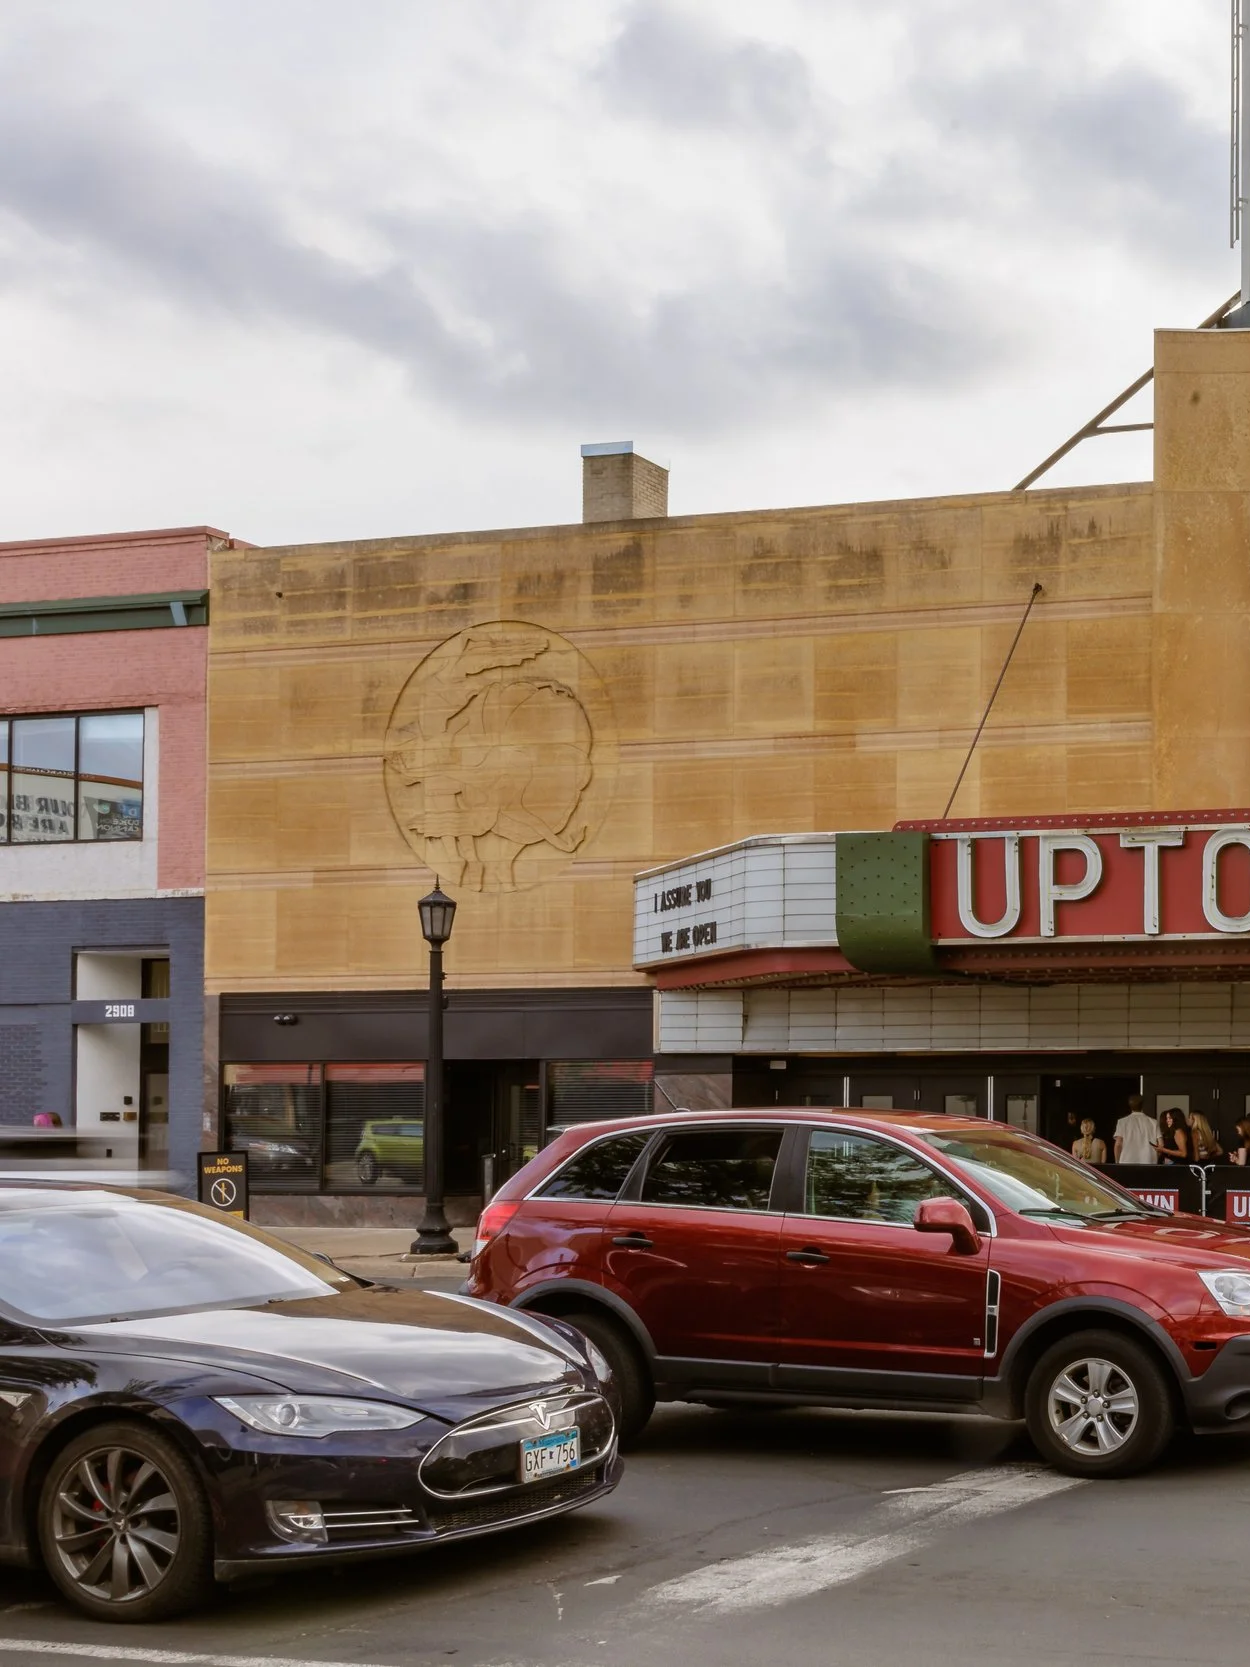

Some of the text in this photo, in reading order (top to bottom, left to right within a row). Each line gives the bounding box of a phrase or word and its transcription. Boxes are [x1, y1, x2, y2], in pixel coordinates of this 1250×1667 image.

[654, 878, 712, 914] I ASSURE YOU
[692, 921, 717, 947] OPEN
[105, 1004, 135, 1018] 2908
[216, 1158, 229, 1166] NO
[203, 1165, 243, 1174] WEAPONS
